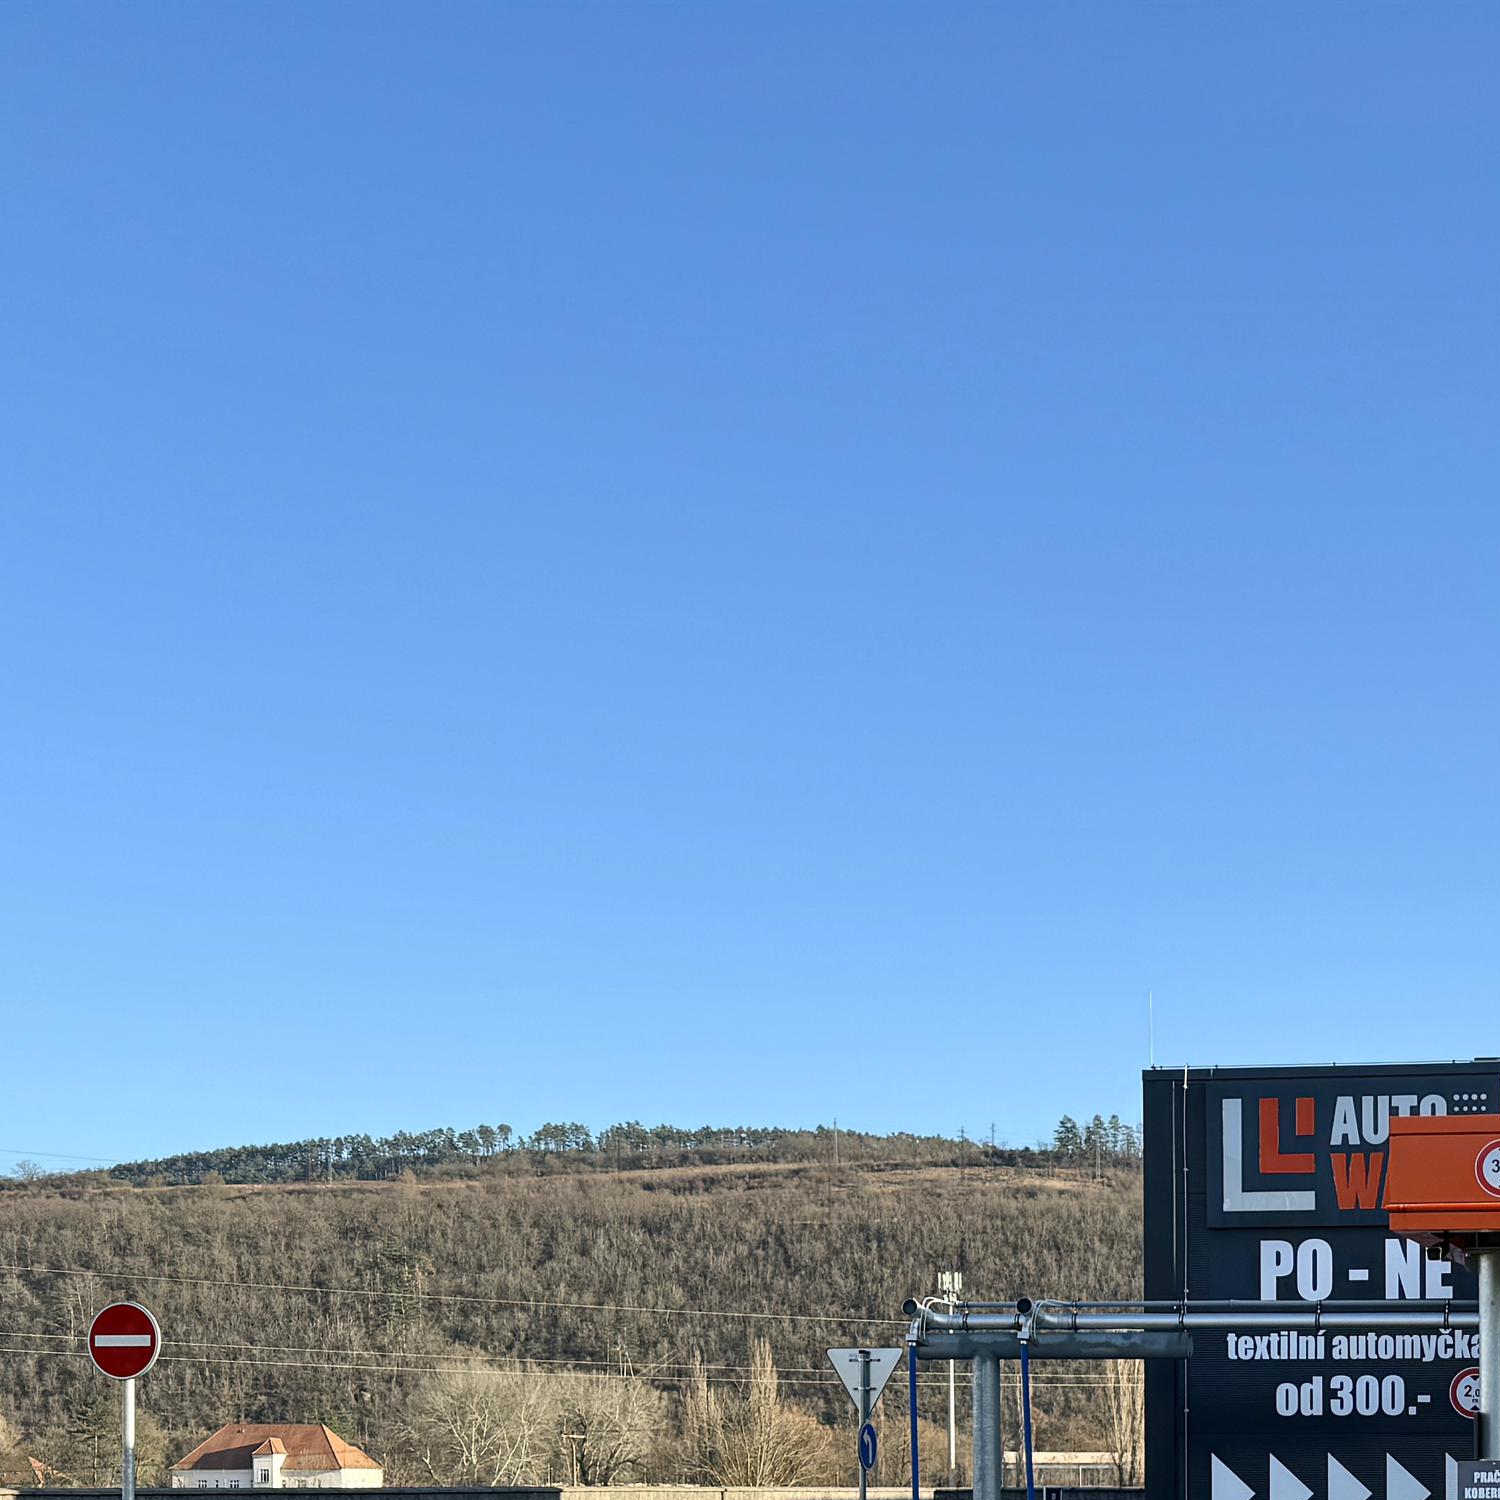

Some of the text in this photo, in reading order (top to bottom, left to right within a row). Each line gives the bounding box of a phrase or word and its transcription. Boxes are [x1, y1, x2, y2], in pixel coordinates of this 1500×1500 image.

[1260, 1239, 1454, 1301] PO - NE
[1227, 1328, 1480, 1362] textilní automyčka
[1275, 1375, 1431, 1416] od 300.-
